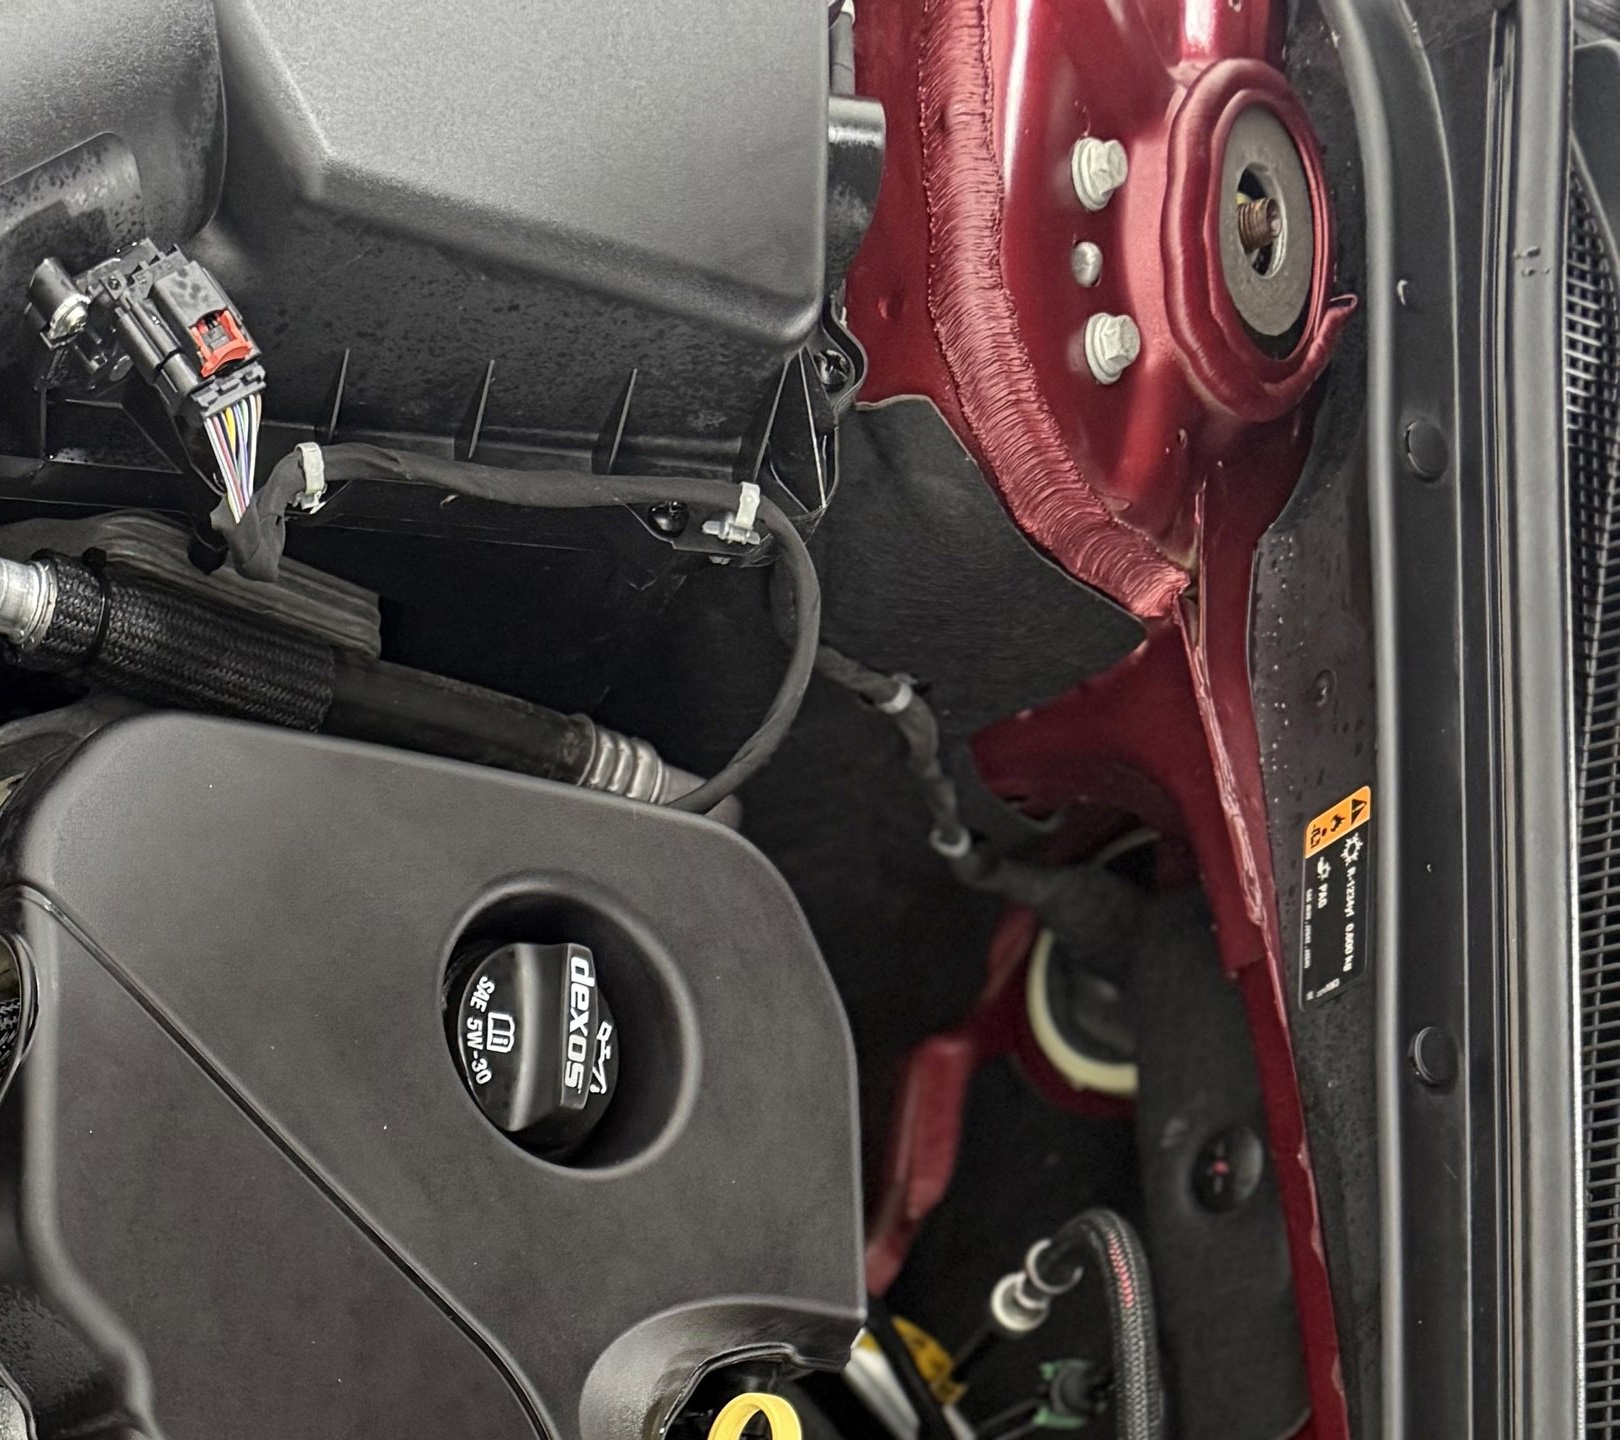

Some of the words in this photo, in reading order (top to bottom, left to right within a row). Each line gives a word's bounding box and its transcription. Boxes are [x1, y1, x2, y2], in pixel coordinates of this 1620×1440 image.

[1317, 883, 1328, 909] PAG
[469, 975, 495, 1013] SAE
[563, 956, 596, 1090] dexos
[466, 1016, 493, 1085] 5W-30
